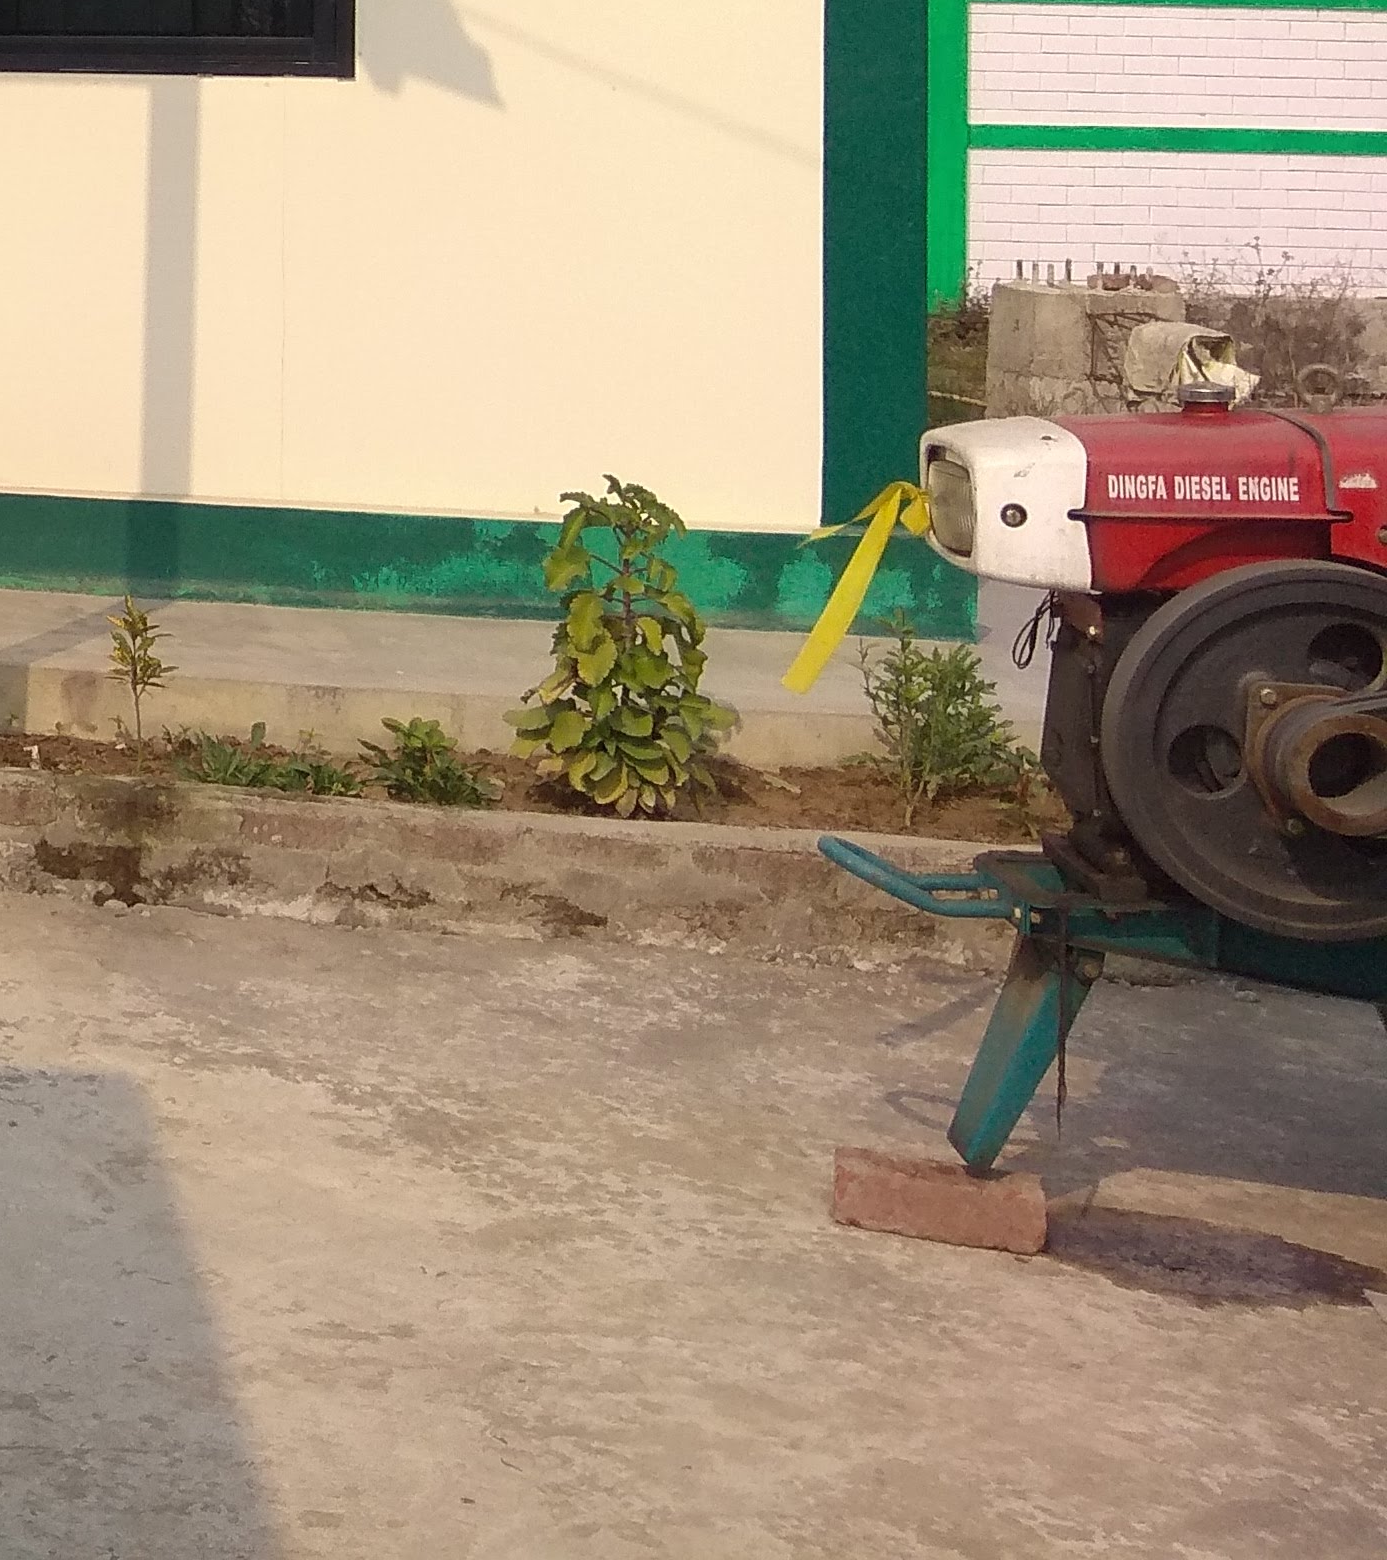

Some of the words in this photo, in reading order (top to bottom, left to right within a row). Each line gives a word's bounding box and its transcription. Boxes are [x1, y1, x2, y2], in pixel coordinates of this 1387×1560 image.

[1107, 474, 1167, 500] DINGFA
[1173, 475, 1231, 501] DIESEL
[1238, 476, 1300, 502] ENGINE
